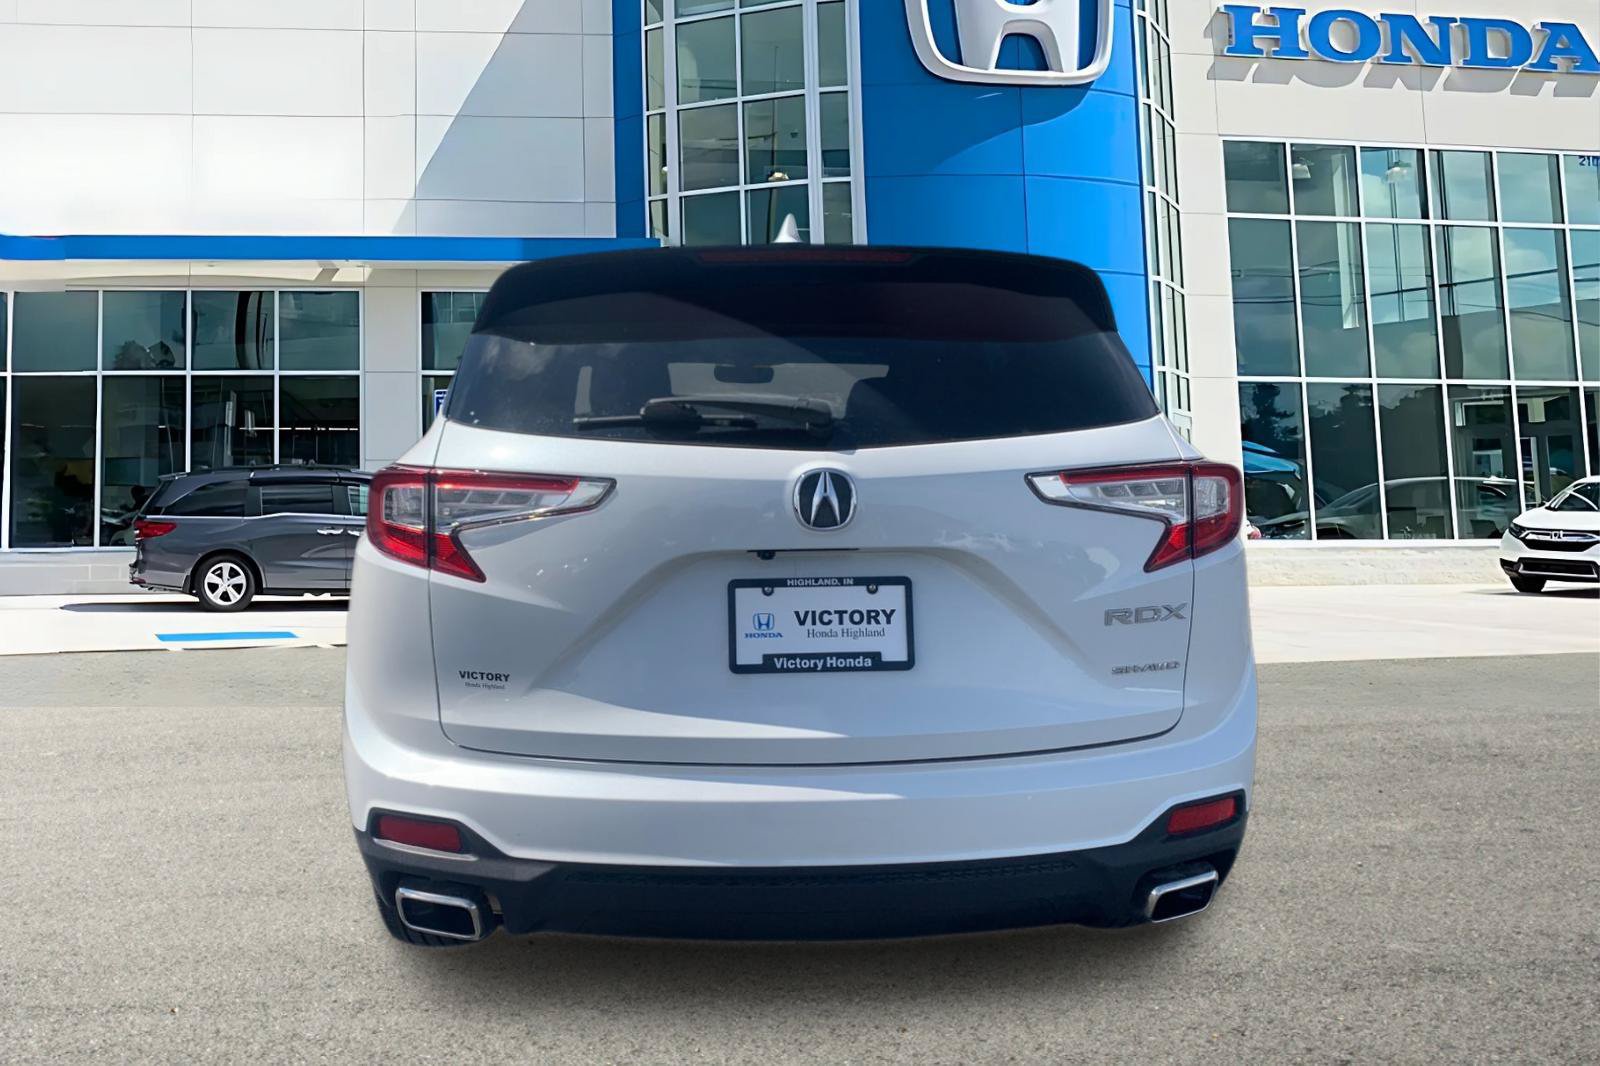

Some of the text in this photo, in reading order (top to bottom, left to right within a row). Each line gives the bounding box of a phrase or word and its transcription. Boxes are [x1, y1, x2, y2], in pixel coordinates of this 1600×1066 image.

[1223, 4, 1600, 73] HONDA
[787, 578, 841, 586] HIGHLAND,
[794, 609, 896, 626] VICTORY
[1104, 602, 1188, 626] RDX
[807, 627, 886, 640] Honda Highland
[774, 655, 872, 670] Victory Honda
[458, 670, 510, 681] VICTORY
